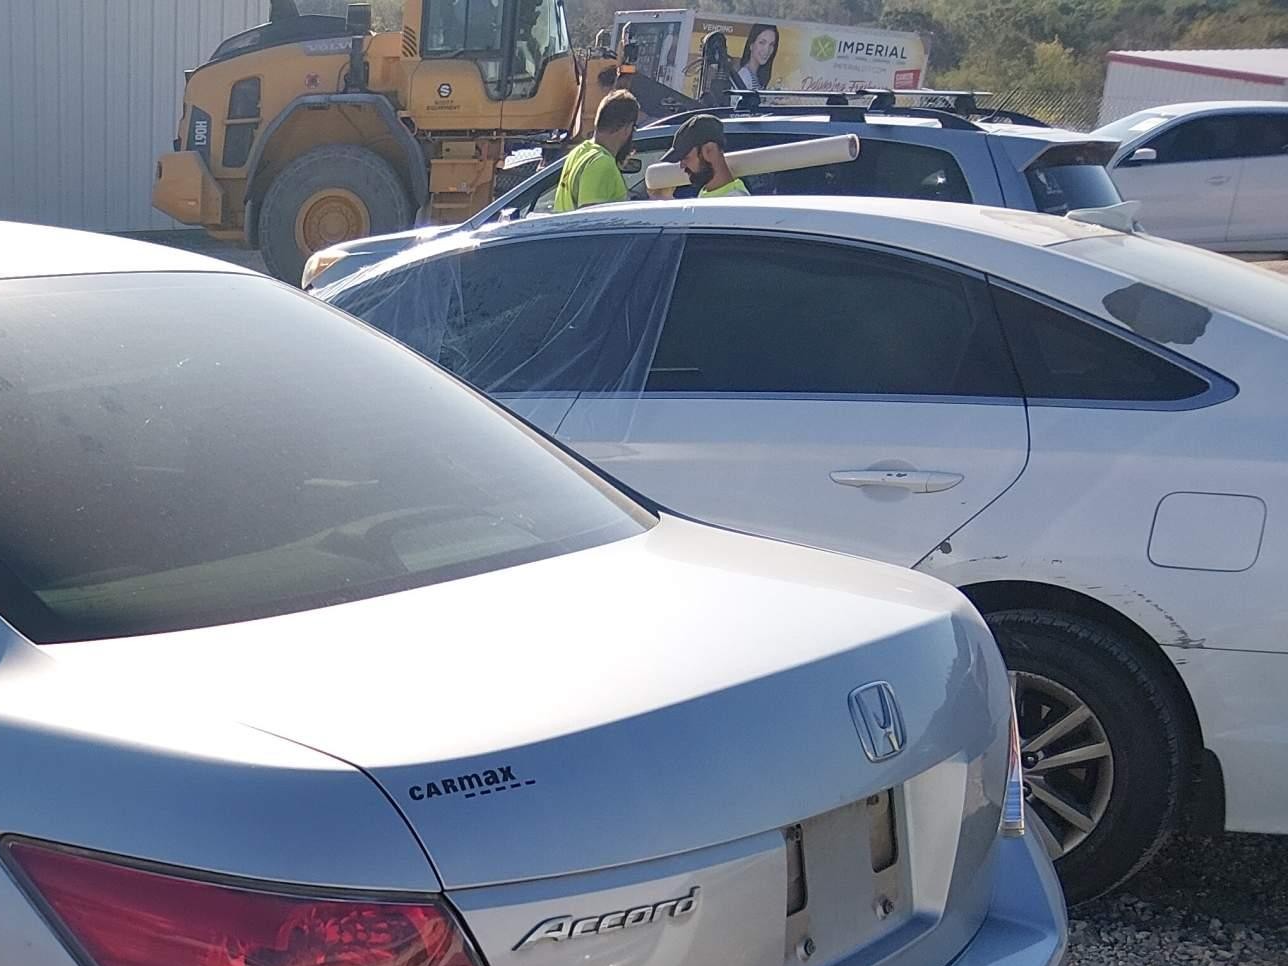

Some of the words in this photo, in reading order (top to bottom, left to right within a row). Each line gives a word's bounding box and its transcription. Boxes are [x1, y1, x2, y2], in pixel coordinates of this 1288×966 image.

[703, 23, 734, 33] VENDING
[838, 40, 908, 59] IMPERIAL
[195, 120, 207, 145] L90H
[512, 886, 701, 951] Accord
